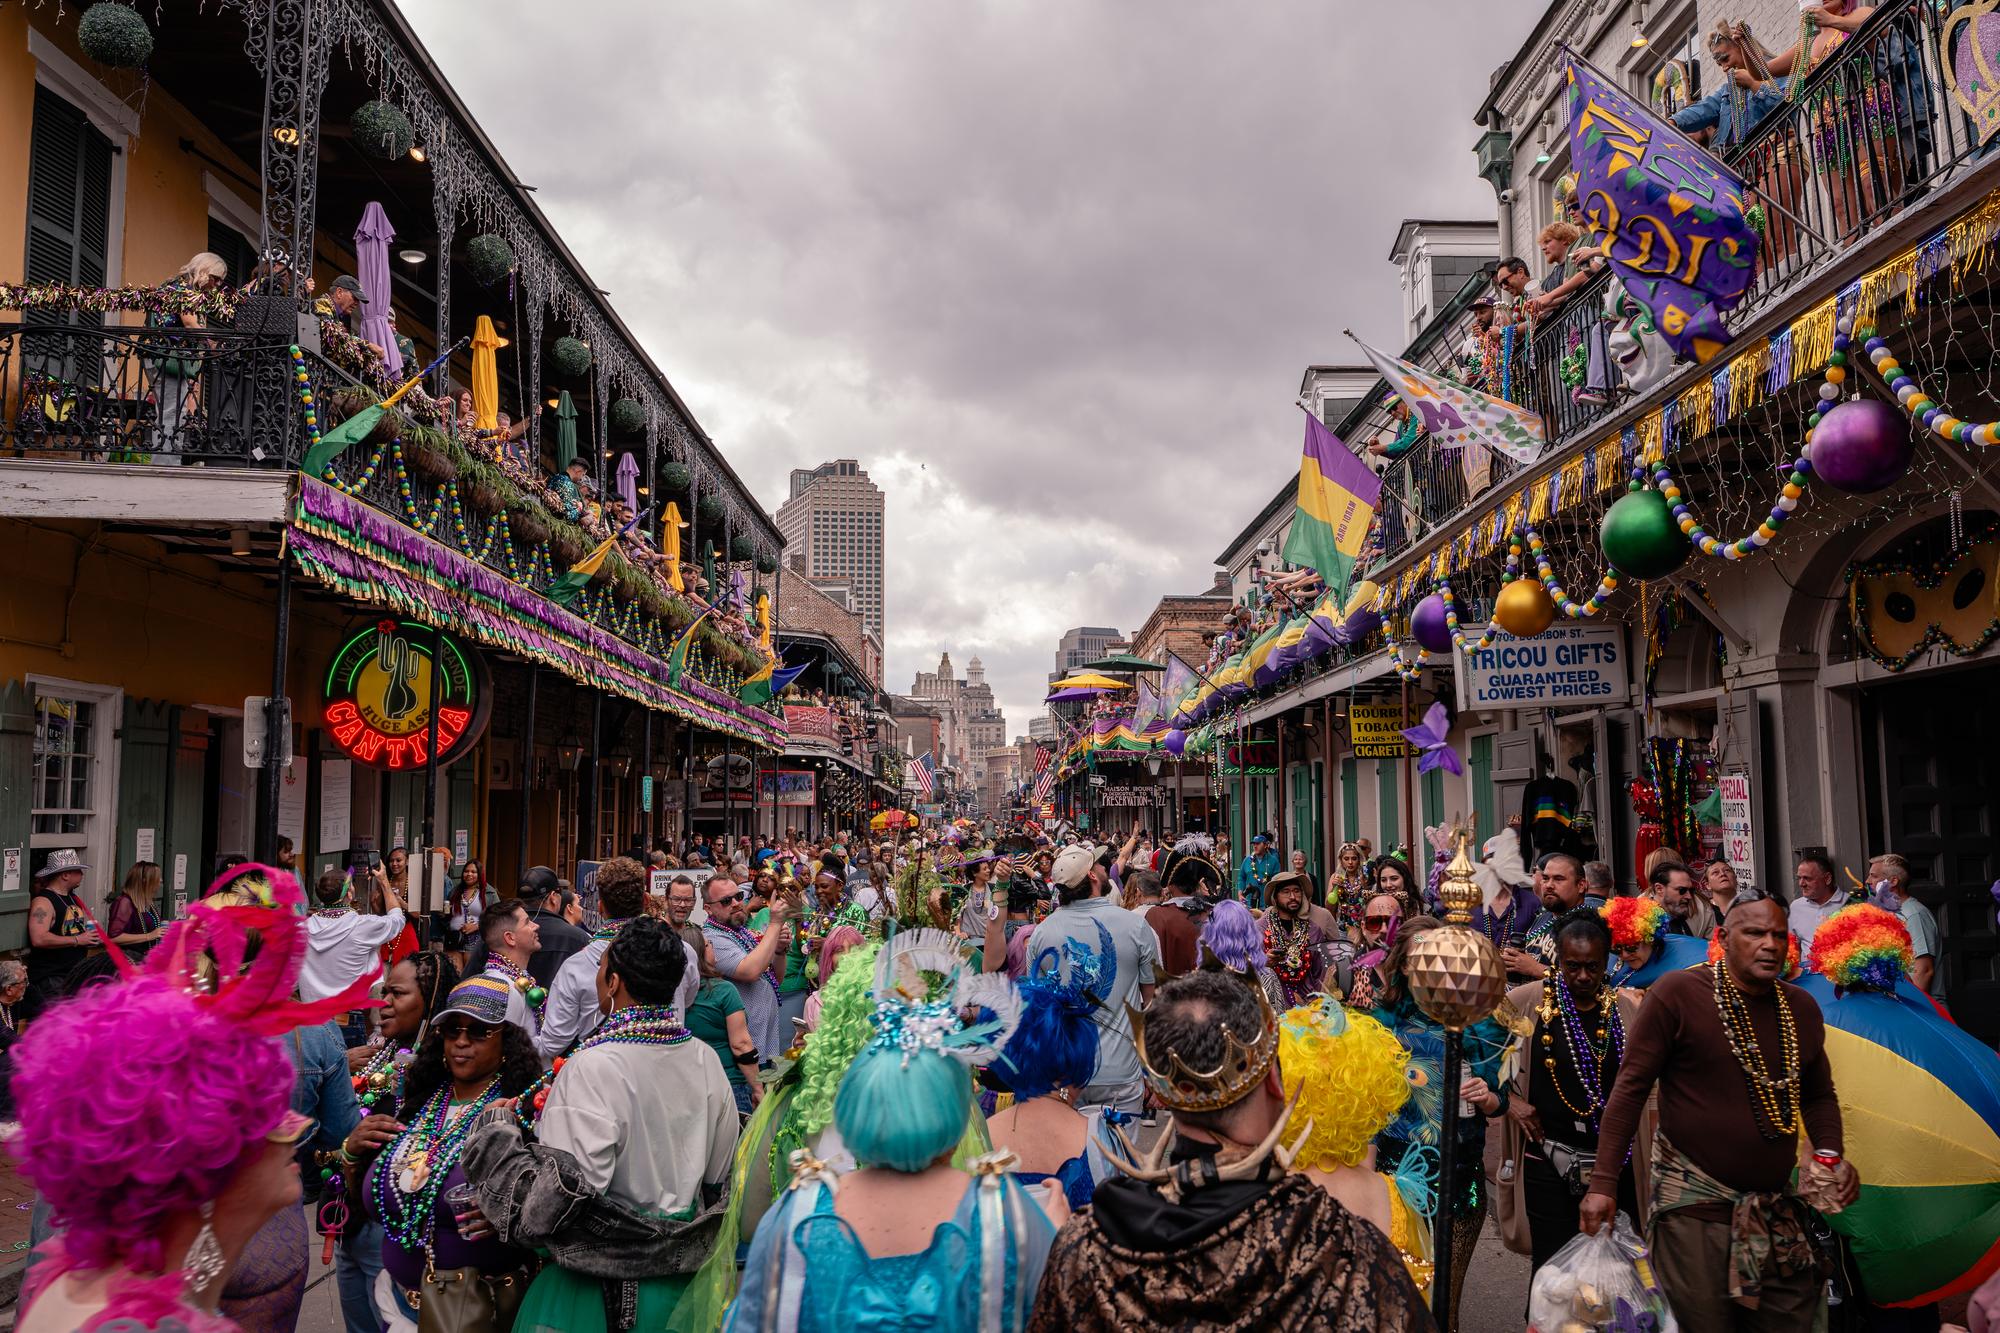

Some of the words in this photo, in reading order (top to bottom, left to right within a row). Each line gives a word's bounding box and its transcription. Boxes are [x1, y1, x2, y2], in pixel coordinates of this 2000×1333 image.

[1569, 628, 1585, 639] ST.
[338, 658, 355, 683] LIVE
[354, 635, 379, 659] LIFE
[440, 643, 466, 693] RANDE
[1471, 646, 1547, 670] TRICOU
[1555, 642, 1617, 666] GIFTS
[1489, 670, 1600, 687] GUARANTEED
[1478, 686, 1546, 701] LOWEST
[1552, 682, 1612, 697] PRICES
[362, 704, 401, 732] HUGE
[407, 708, 430, 731] ASS
[326, 701, 469, 767] CANTINA
[1224, 765, 1280, 774] meow
[1102, 793, 1148, 806] PRESERVATION
[1720, 779, 1748, 800] SPECIAL
[1732, 839, 1750, 862] $25
